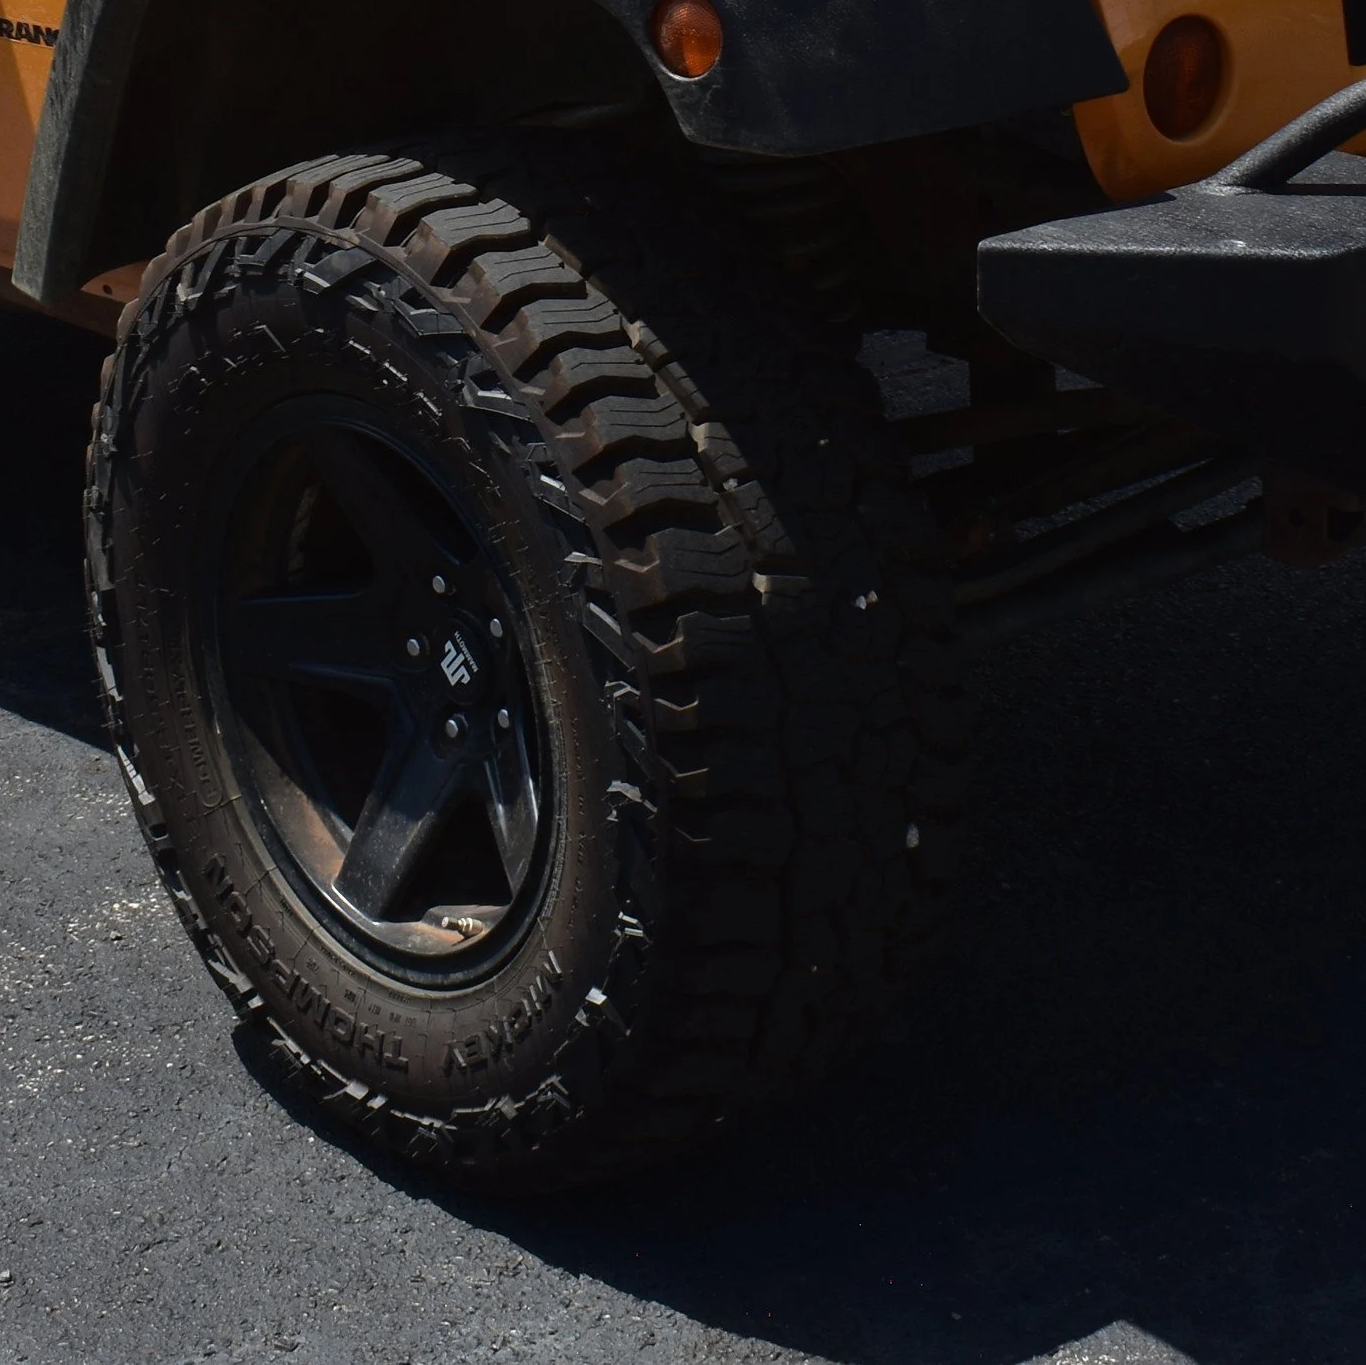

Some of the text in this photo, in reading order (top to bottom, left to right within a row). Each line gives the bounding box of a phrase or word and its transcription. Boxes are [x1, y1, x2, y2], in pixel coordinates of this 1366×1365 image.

[454, 630, 479, 673] MAMMOTH
[200, 852, 564, 1081] MICKEY THOMPSON
